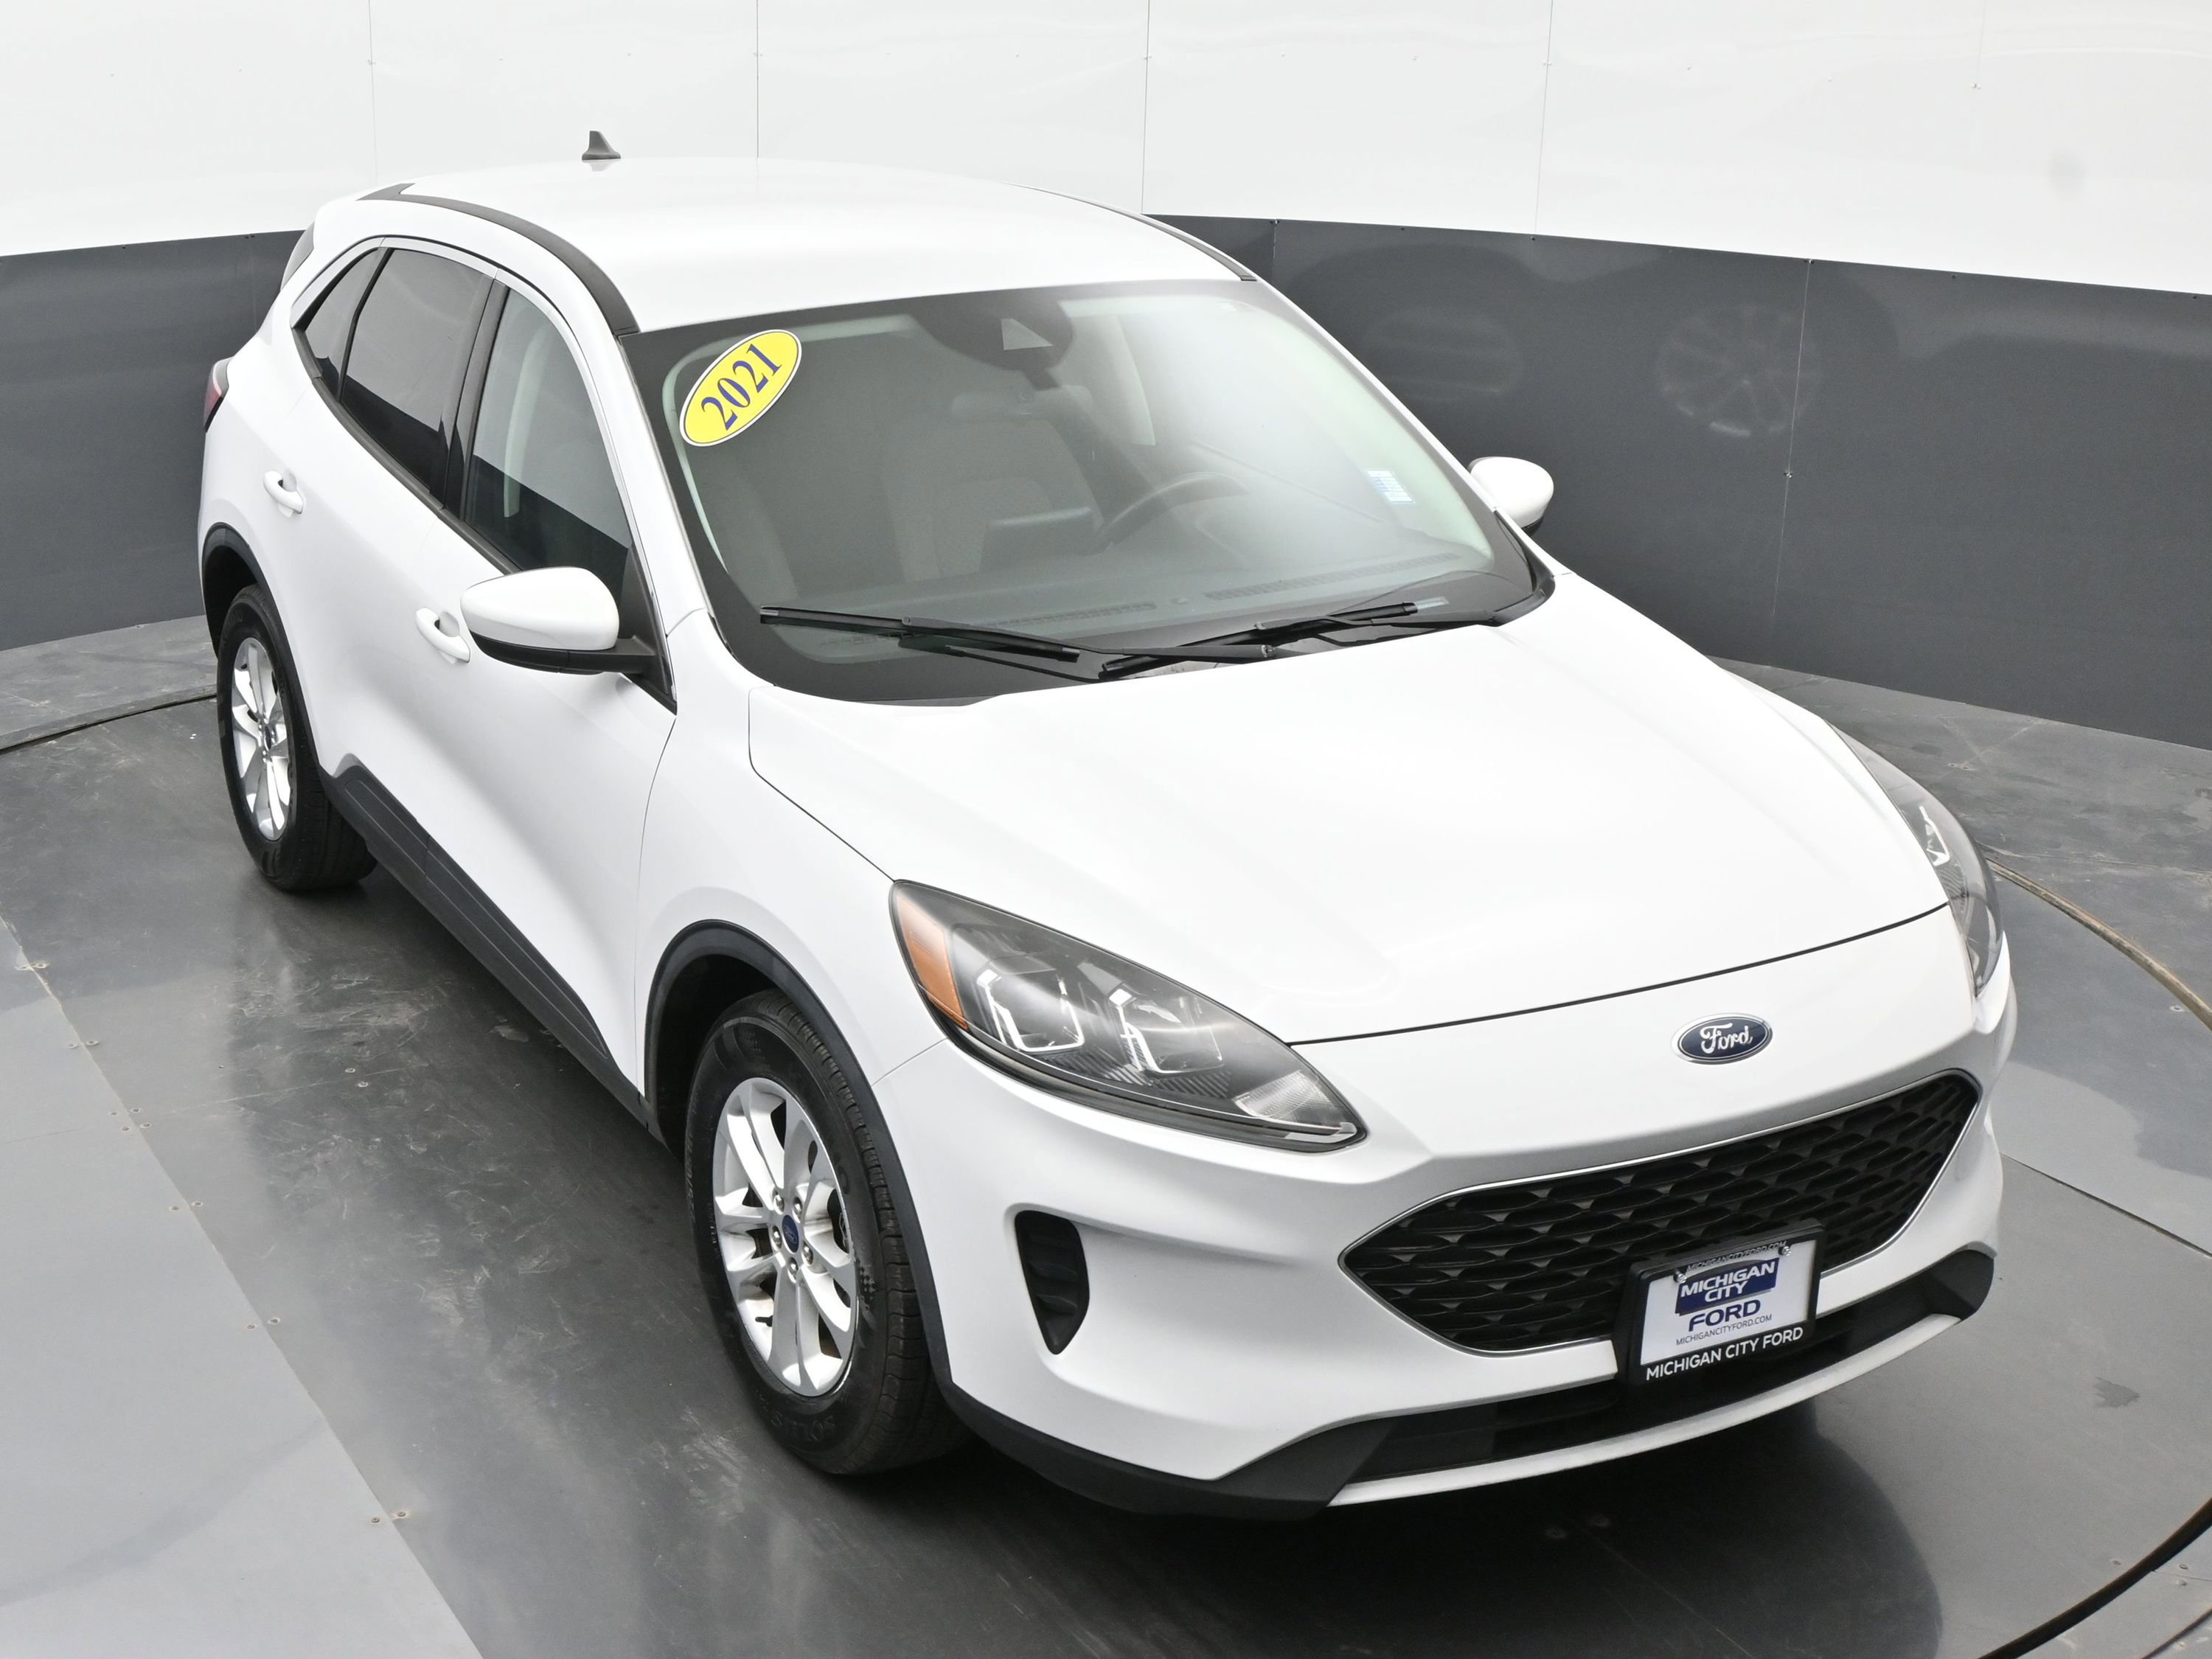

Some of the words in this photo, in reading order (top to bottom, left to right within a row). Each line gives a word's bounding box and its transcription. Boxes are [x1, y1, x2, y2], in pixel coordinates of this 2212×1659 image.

[701, 344, 782, 431] 2021
[1700, 1023, 1753, 1054] Ford
[1680, 1261, 1775, 1297] MICHIGAN
[1705, 1282, 1747, 1302] CITY
[1676, 1314, 1772, 1346] MICHIGANCITYFORD.COM
[1688, 1299, 1761, 1332] FORD
[1646, 1349, 1722, 1381] MICHIGAN
[1725, 1338, 1759, 1359] CITY
[1762, 1327, 1804, 1351] FORD
